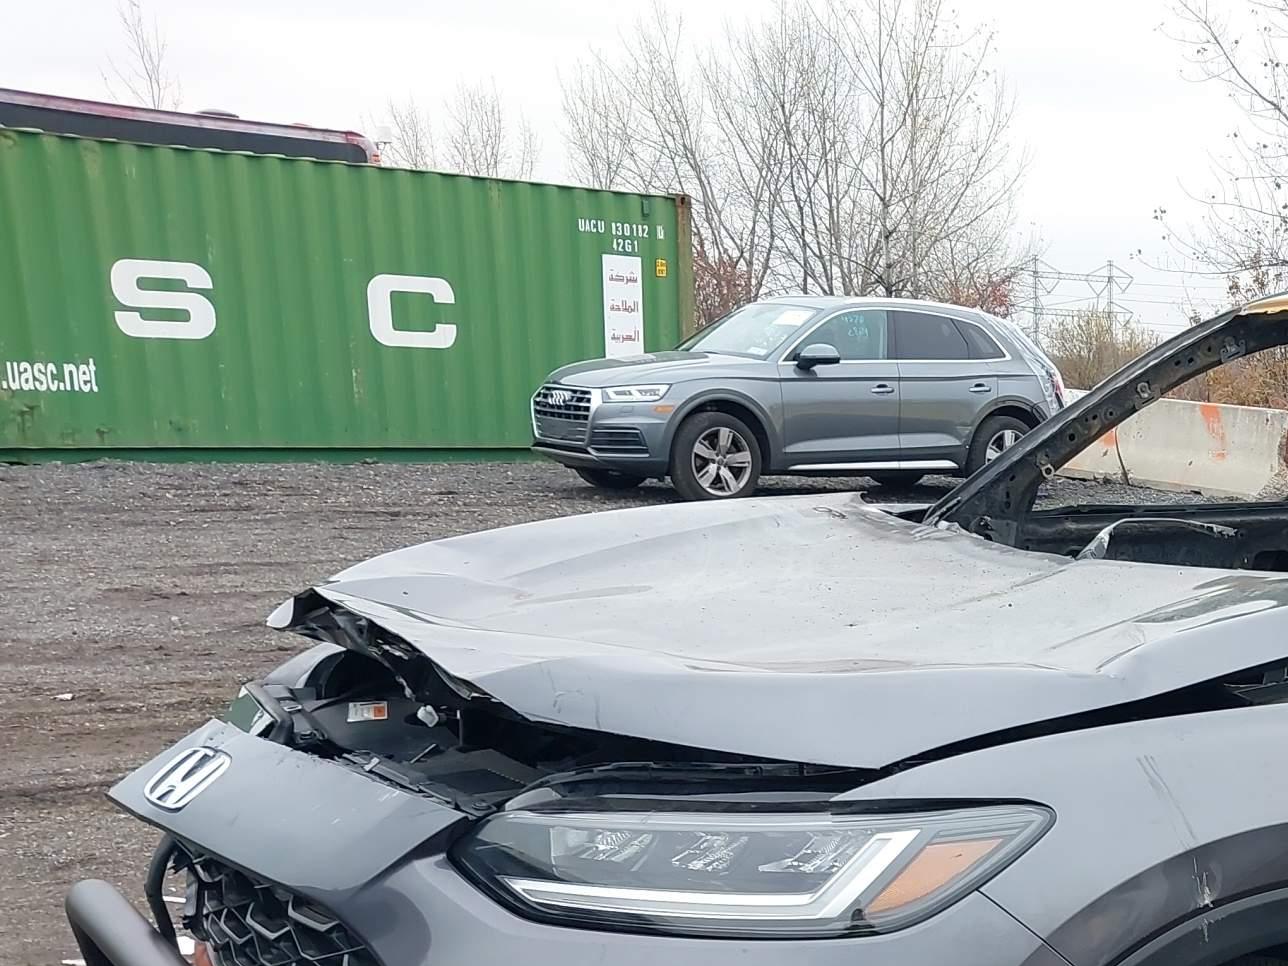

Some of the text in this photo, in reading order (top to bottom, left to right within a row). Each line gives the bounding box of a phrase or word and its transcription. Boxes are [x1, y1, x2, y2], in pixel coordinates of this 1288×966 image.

[578, 218, 605, 233] UACU
[612, 238, 638, 252] 42G1
[608, 268, 638, 285] شركة
[110, 258, 458, 349] S C
[609, 298, 639, 314] الملاحة
[610, 328, 640, 344] العربية
